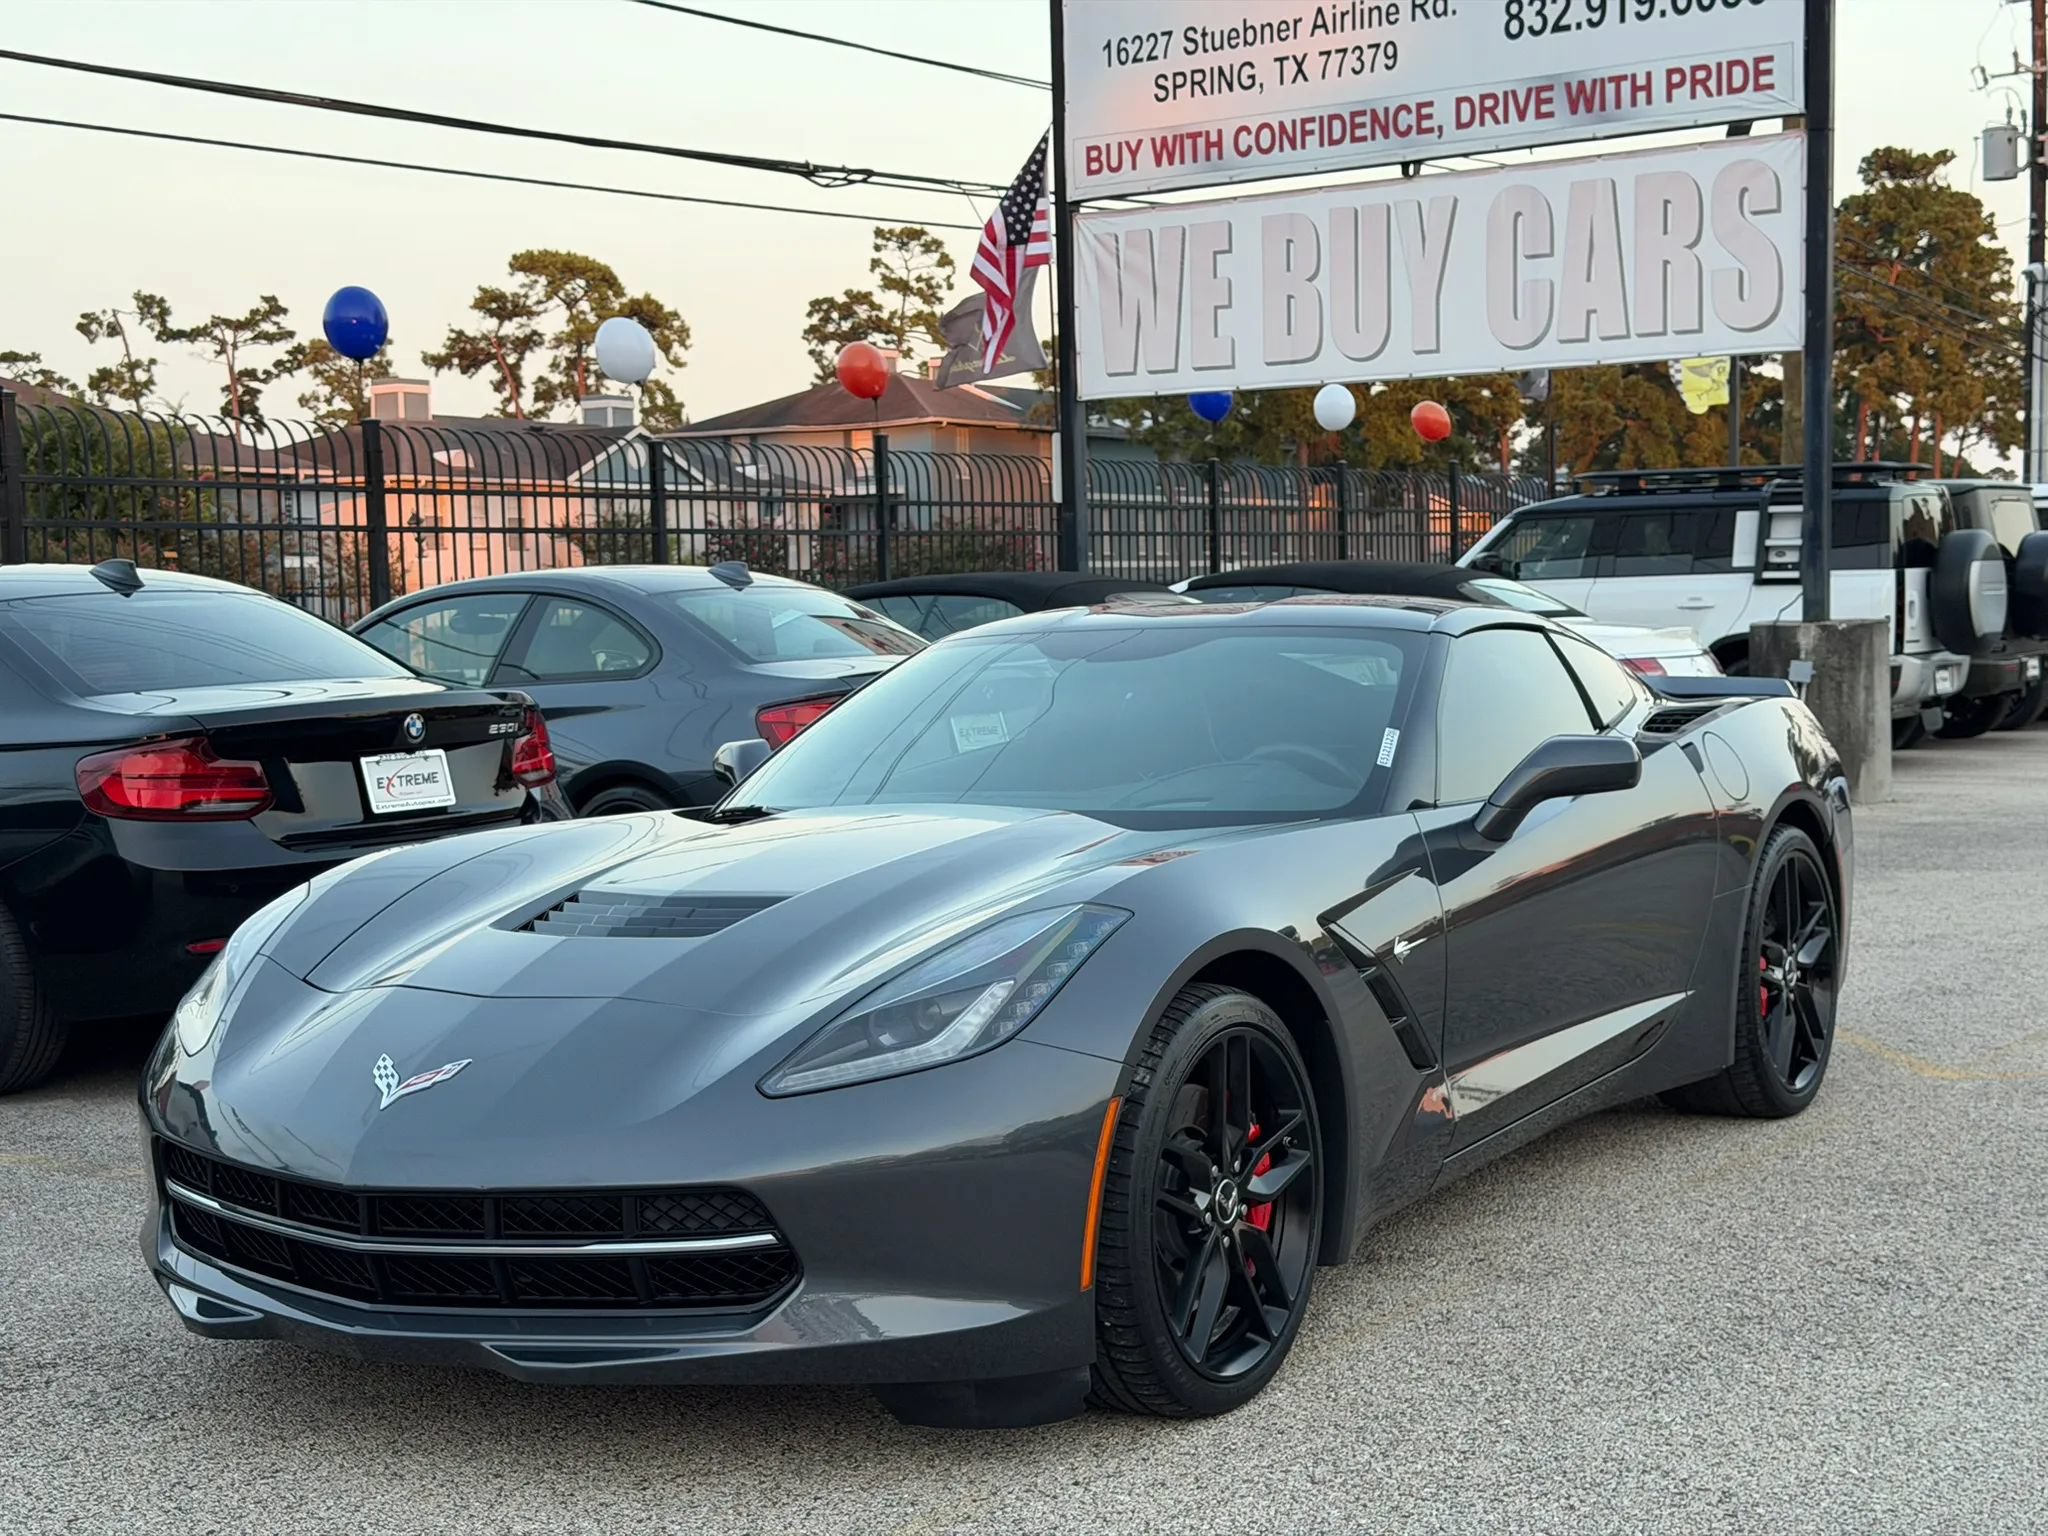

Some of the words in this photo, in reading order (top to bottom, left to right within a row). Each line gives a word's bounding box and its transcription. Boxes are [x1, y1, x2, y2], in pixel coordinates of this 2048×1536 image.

[1102, 30, 1174, 68] 16227
[1183, 17, 1303, 57] Stuebner
[1310, 0, 1400, 37] Airline
[1411, 0, 1457, 21] Rd.
[1503, 0, 1766, 40] 832.919.
[1154, 61, 1265, 103] SPRING,
[1274, 53, 1309, 86] TX
[1319, 40, 1399, 80] 77379
[1086, 139, 1143, 177] BUY
[1151, 128, 1223, 168] WITH
[1233, 101, 1444, 158] CONFIDENCE,
[1455, 84, 1555, 131] DRIVE
[1564, 71, 1653, 116] WITH
[1665, 55, 1775, 103] PRIDE
[1100, 220, 1235, 377] WE
[1260, 195, 1458, 366] BUY
[1485, 159, 1784, 350] CARS
[376, 771, 439, 790] EXTREME
